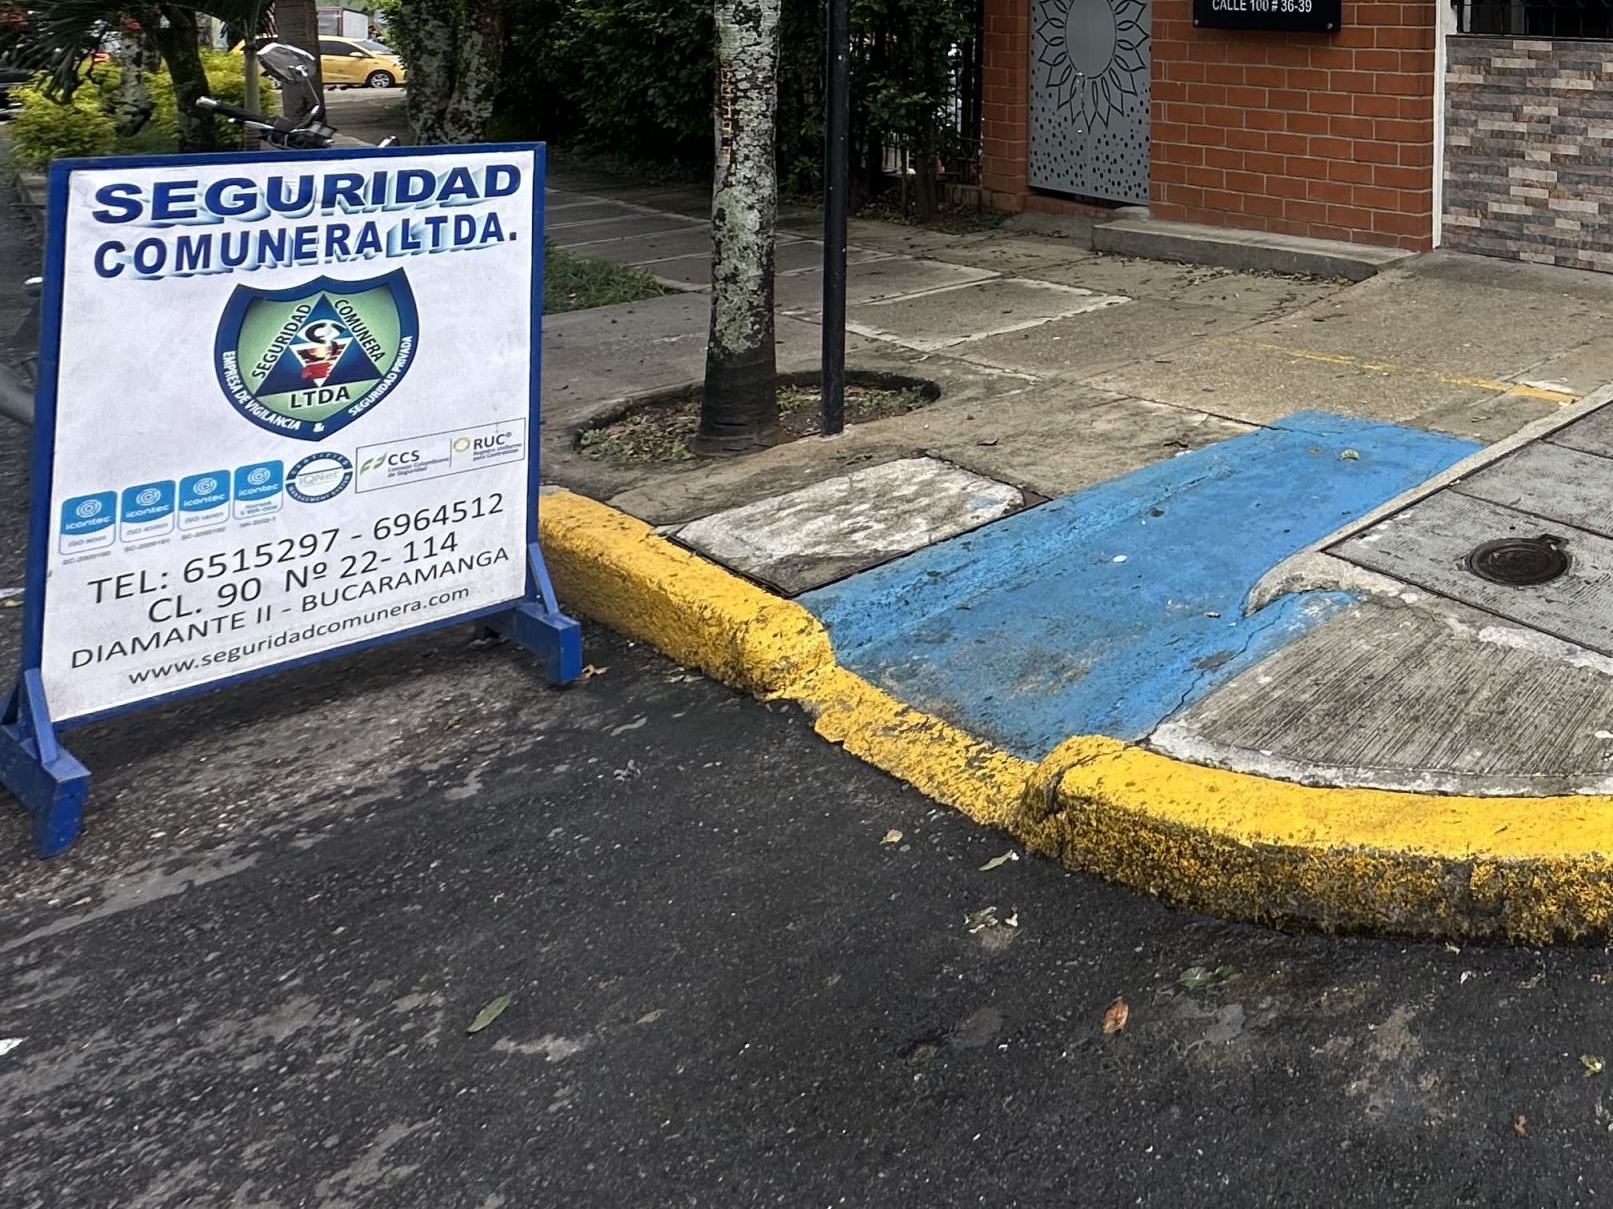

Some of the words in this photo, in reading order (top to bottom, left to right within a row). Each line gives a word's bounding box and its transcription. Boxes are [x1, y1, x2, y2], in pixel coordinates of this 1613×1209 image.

[92, 164, 522, 225] SEGURIDAD
[94, 221, 383, 279] COMUNERA
[400, 212, 518, 252] LTDA.
[252, 303, 312, 380] SEGURIDAD
[334, 299, 386, 363] COMUNERA
[223, 350, 244, 394] EMPRESA
[234, 393, 252, 404] DE
[244, 398, 302, 431] VIGILANCIA
[290, 386, 350, 409] LTDA
[348, 373, 398, 416] SEGURIDAD
[394, 335, 413, 373] PRIVADA
[238, 482, 279, 497] icontec
[388, 450, 420, 466] CCS
[65, 515, 112, 530] icontec
[125, 503, 170, 518] icontec
[183, 493, 226, 507] icontec
[87, 569, 168, 604] TEL:
[183, 528, 340, 583] 6515297
[373, 493, 503, 540] 6964512
[148, 595, 202, 623] CL.
[217, 577, 262, 608] 90
[285, 561, 327, 593] Nº
[403, 531, 458, 564] 114
[71, 611, 246, 669] DIAMANTE
[256, 604, 271, 624] II
[302, 546, 509, 613] BUCARAMANGA
[128, 587, 470, 684] www.seguridadcomunera.com
